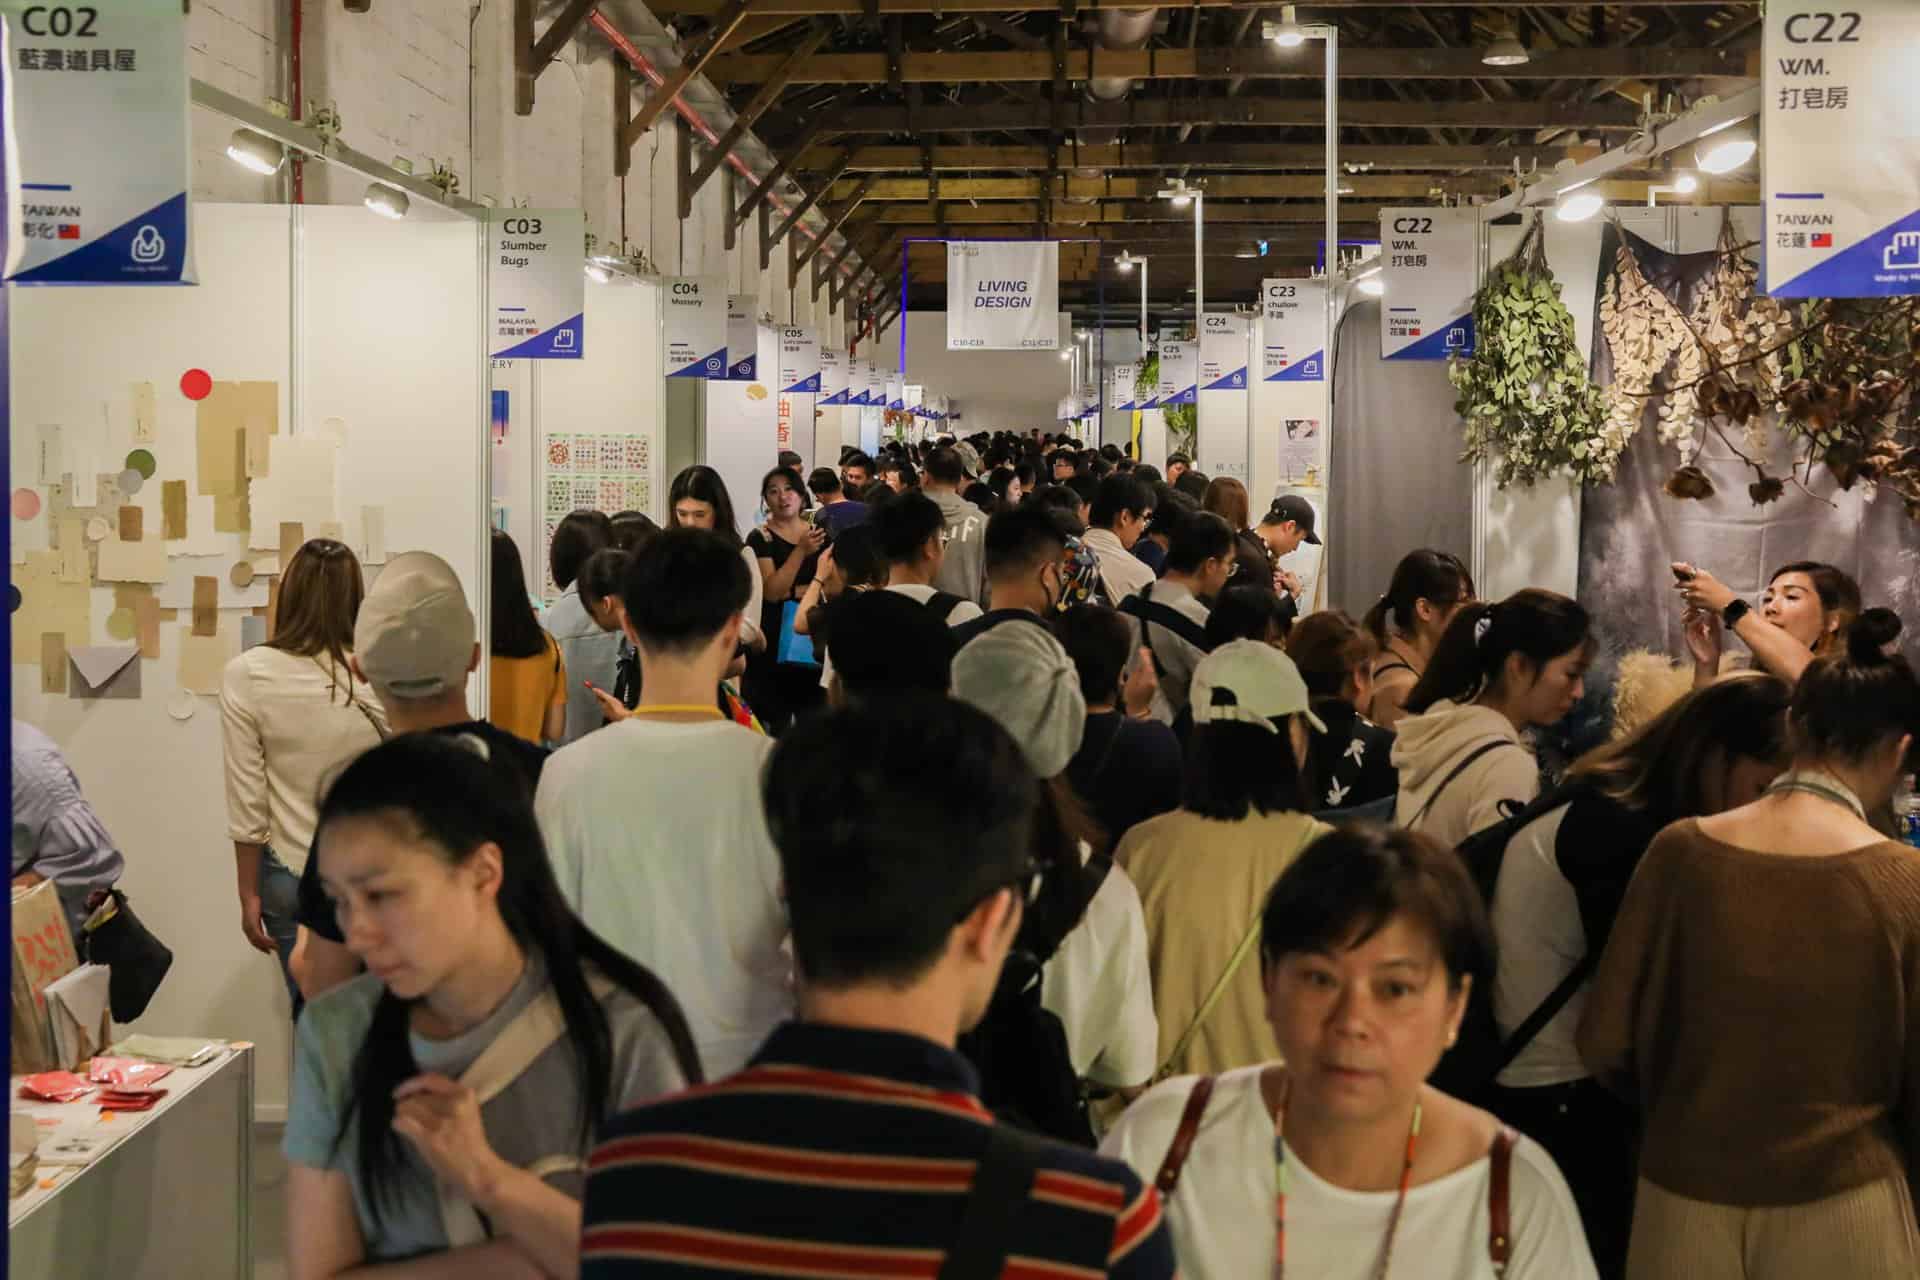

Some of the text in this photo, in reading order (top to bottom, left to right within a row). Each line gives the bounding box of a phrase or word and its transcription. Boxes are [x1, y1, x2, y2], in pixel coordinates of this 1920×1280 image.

[22, 6, 98, 37] C02
[1784, 12, 1861, 43] C22
[1779, 58, 1830, 75] WM.
[1779, 86, 1849, 110] 打皂房
[22, 204, 81, 217] TAIWAN
[1393, 218, 1433, 233] C22
[1776, 214, 1833, 225] TAIWAN
[503, 218, 542, 234] C03
[501, 240, 547, 250] Slumber
[1392, 240, 1418, 250] WM.
[501, 255, 529, 268] Bugs
[1392, 254, 1427, 267] 打皂房
[672, 283, 699, 295] C04
[978, 281, 1028, 292] LIVING
[1270, 286, 1296, 297] C23
[974, 296, 1032, 308] DESIGN
[1206, 317, 1226, 326] C24
[784, 329, 803, 337] C05
